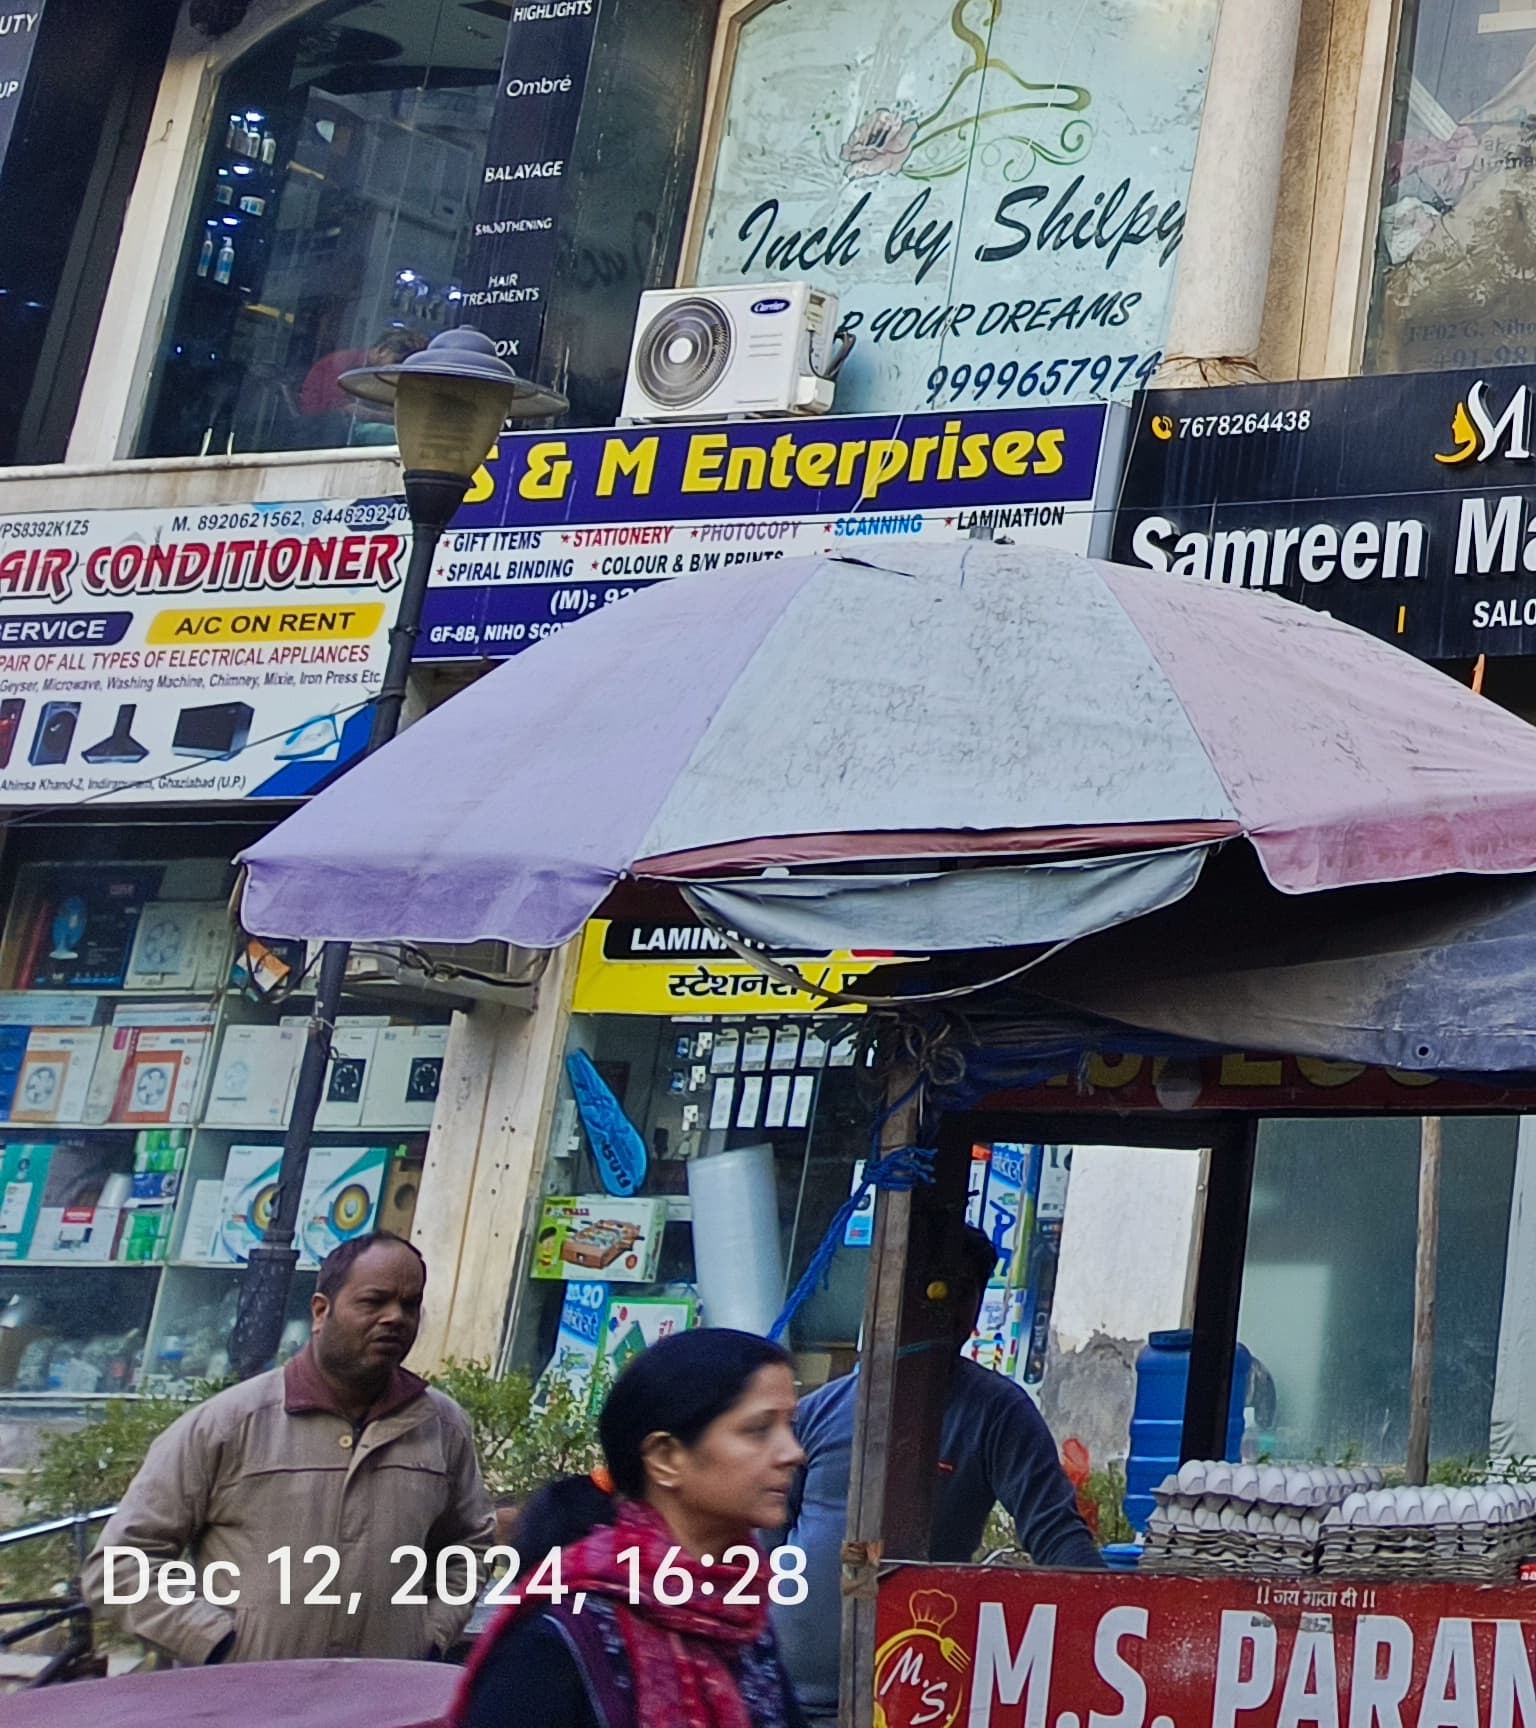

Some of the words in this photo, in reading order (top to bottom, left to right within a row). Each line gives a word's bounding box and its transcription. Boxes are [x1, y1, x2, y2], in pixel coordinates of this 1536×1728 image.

[513, 0, 593, 23] HIGHLIGHTS
[484, 160, 563, 184] BALAYAGE
[739, 191, 872, 275] Inch
[886, 187, 953, 285] by
[870, 303, 975, 344] YOUR
[977, 291, 1142, 336] DREAMS
[1178, 409, 1311, 440] 7678264438
[680, 420, 1066, 498] Enterprises
[493, 531, 542, 551] ITEMS
[572, 525, 674, 548] STATIONERY
[700, 520, 801, 543] PHOTOCOPY
[834, 513, 924, 537] SCANNING
[957, 506, 1066, 531] LAMINATION
[85, 535, 401, 592] CONDITIONER
[447, 561, 502, 583] SPIRAL
[506, 559, 574, 579] BINDING
[601, 554, 669, 576] COLOUR
[1131, 515, 1424, 589] Samreen
[175, 616, 222, 636] A/C
[231, 615, 271, 633] ON
[279, 612, 356, 633] RENT
[91, 652, 140, 670] TYPES
[169, 647, 265, 668] ELECTRICAL
[268, 644, 371, 665] APPLIANCES
